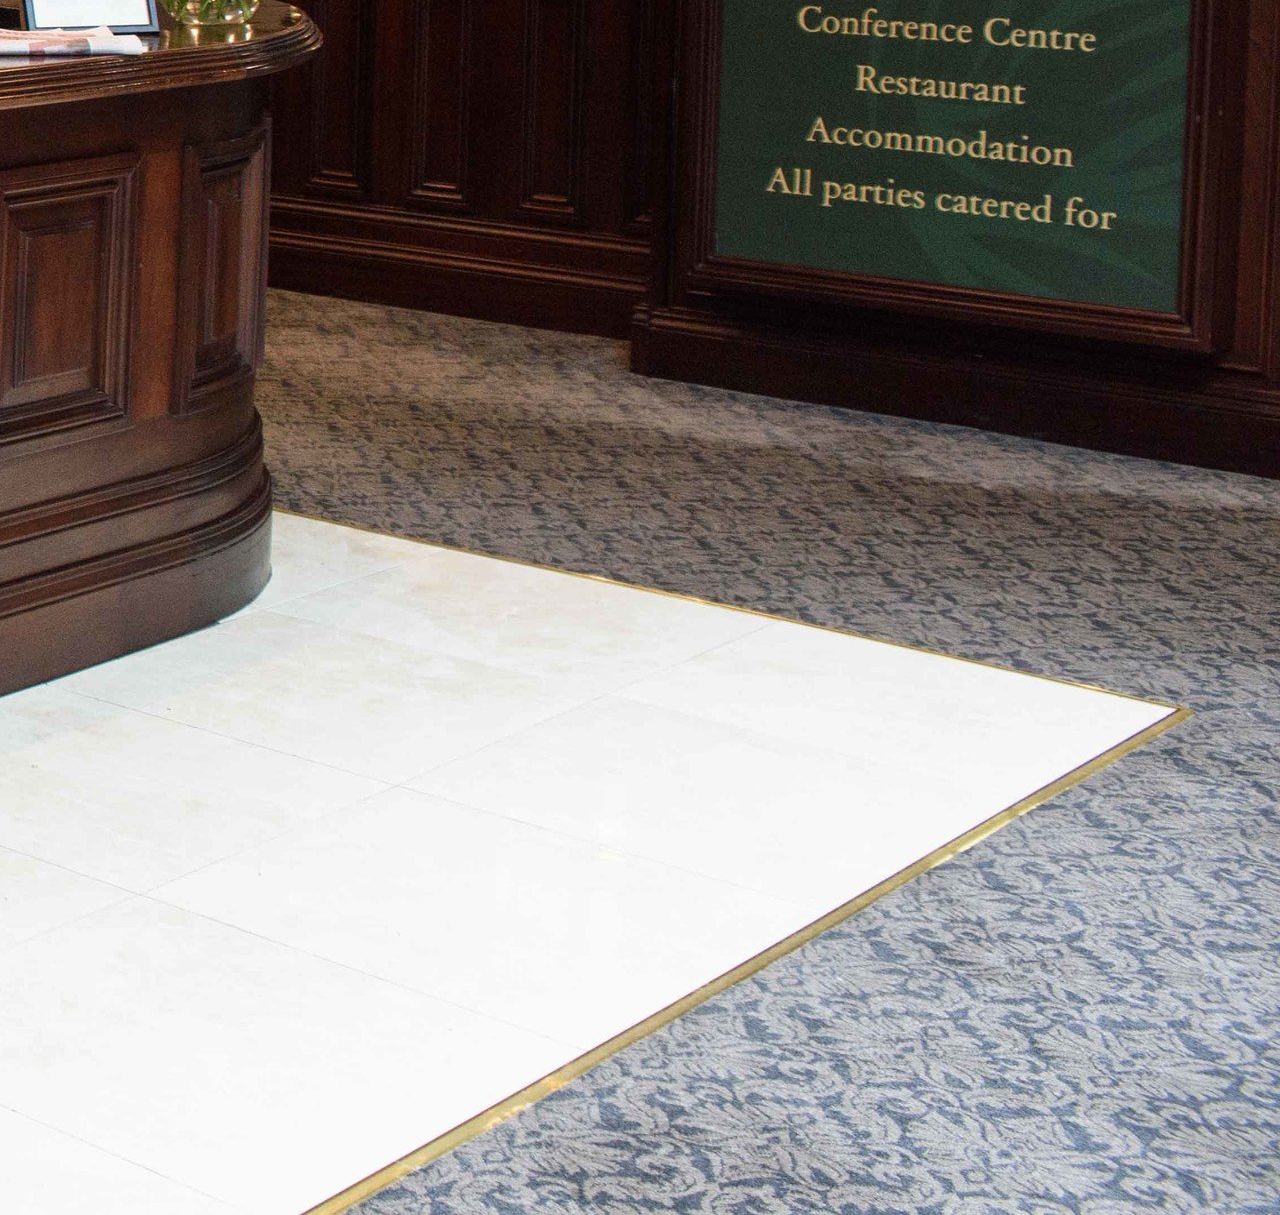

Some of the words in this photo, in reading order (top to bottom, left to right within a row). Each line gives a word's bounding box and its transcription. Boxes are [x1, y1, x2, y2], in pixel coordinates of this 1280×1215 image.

[797, 5, 973, 44] Conference
[983, 17, 1097, 53] Centre
[855, 64, 1026, 105] Restaurant
[806, 116, 1074, 168] Accommodation
[766, 167, 812, 197] All
[822, 178, 926, 210] parties
[935, 193, 1052, 224] catered
[1064, 196, 1117, 230] for
